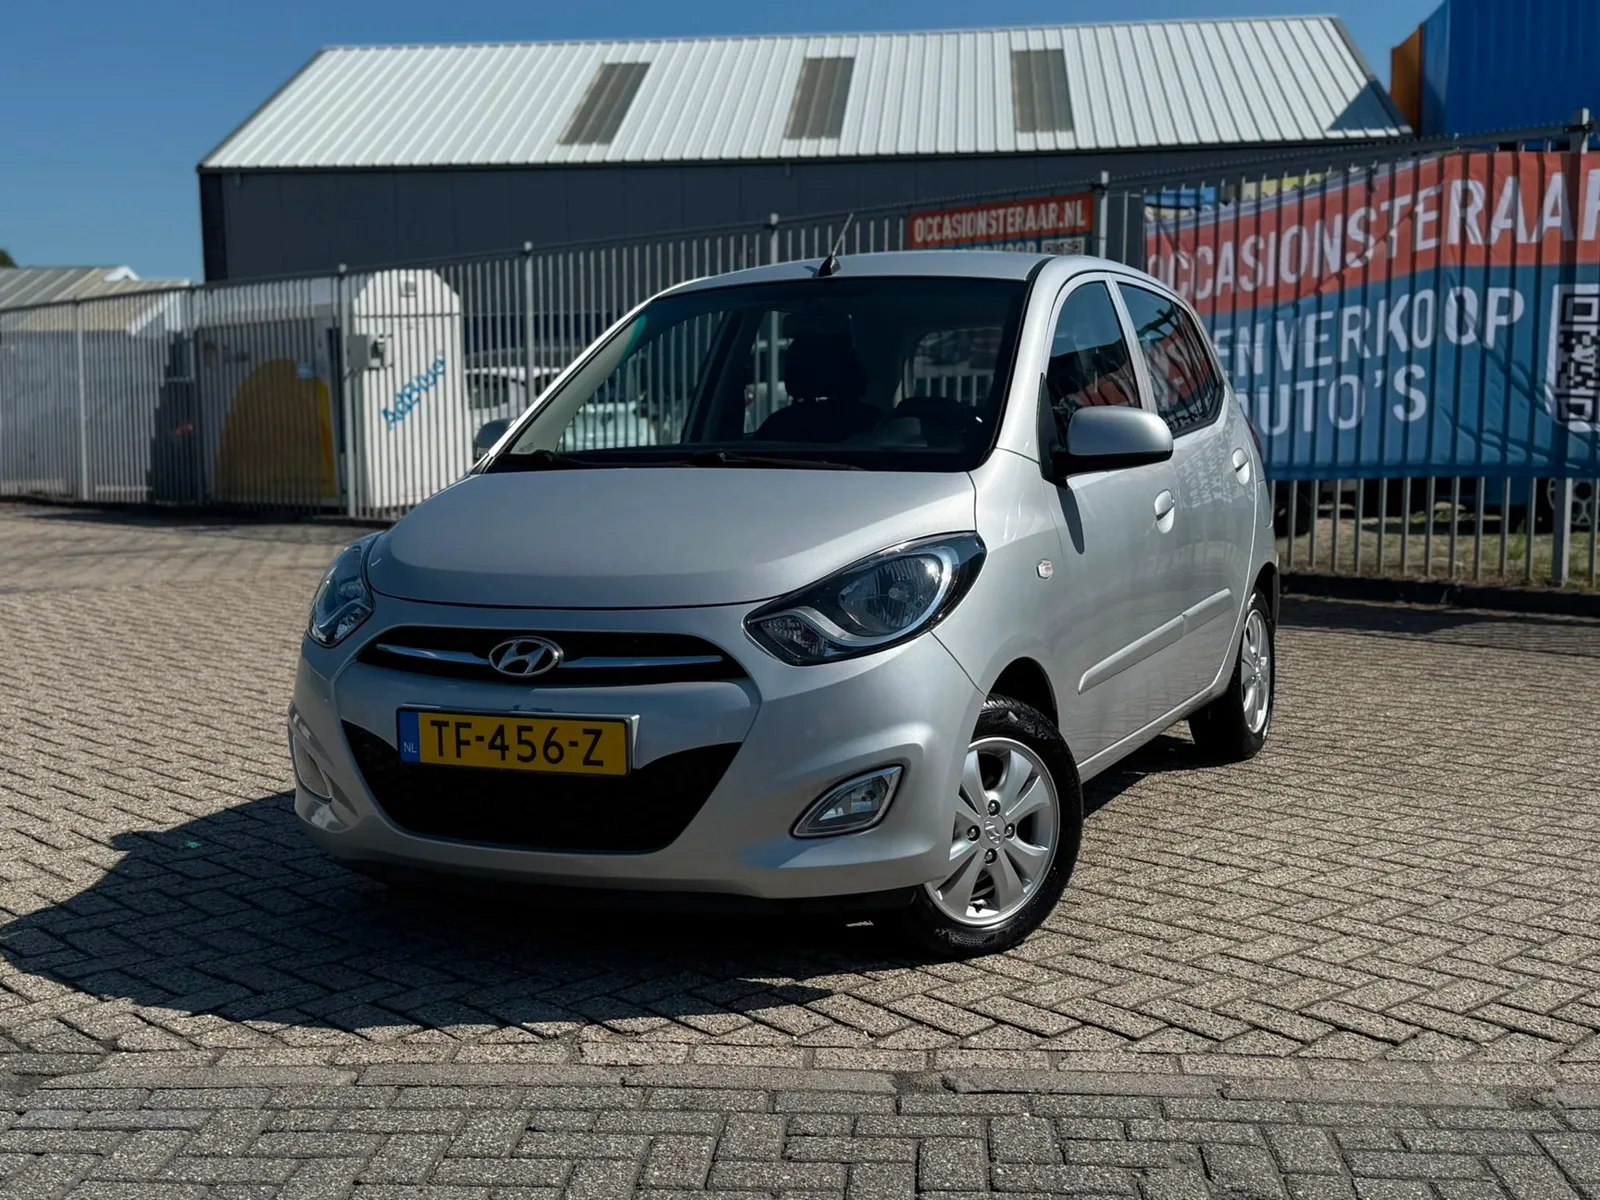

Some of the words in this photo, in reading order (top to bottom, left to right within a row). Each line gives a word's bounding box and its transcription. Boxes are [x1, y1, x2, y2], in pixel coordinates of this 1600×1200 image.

[913, 199, 1086, 244] OCCASIONSTERAAR.NL
[1275, 287, 1525, 372] VERKOOP
[403, 741, 418, 754] NL
[429, 719, 605, 767] TF-456-Z
